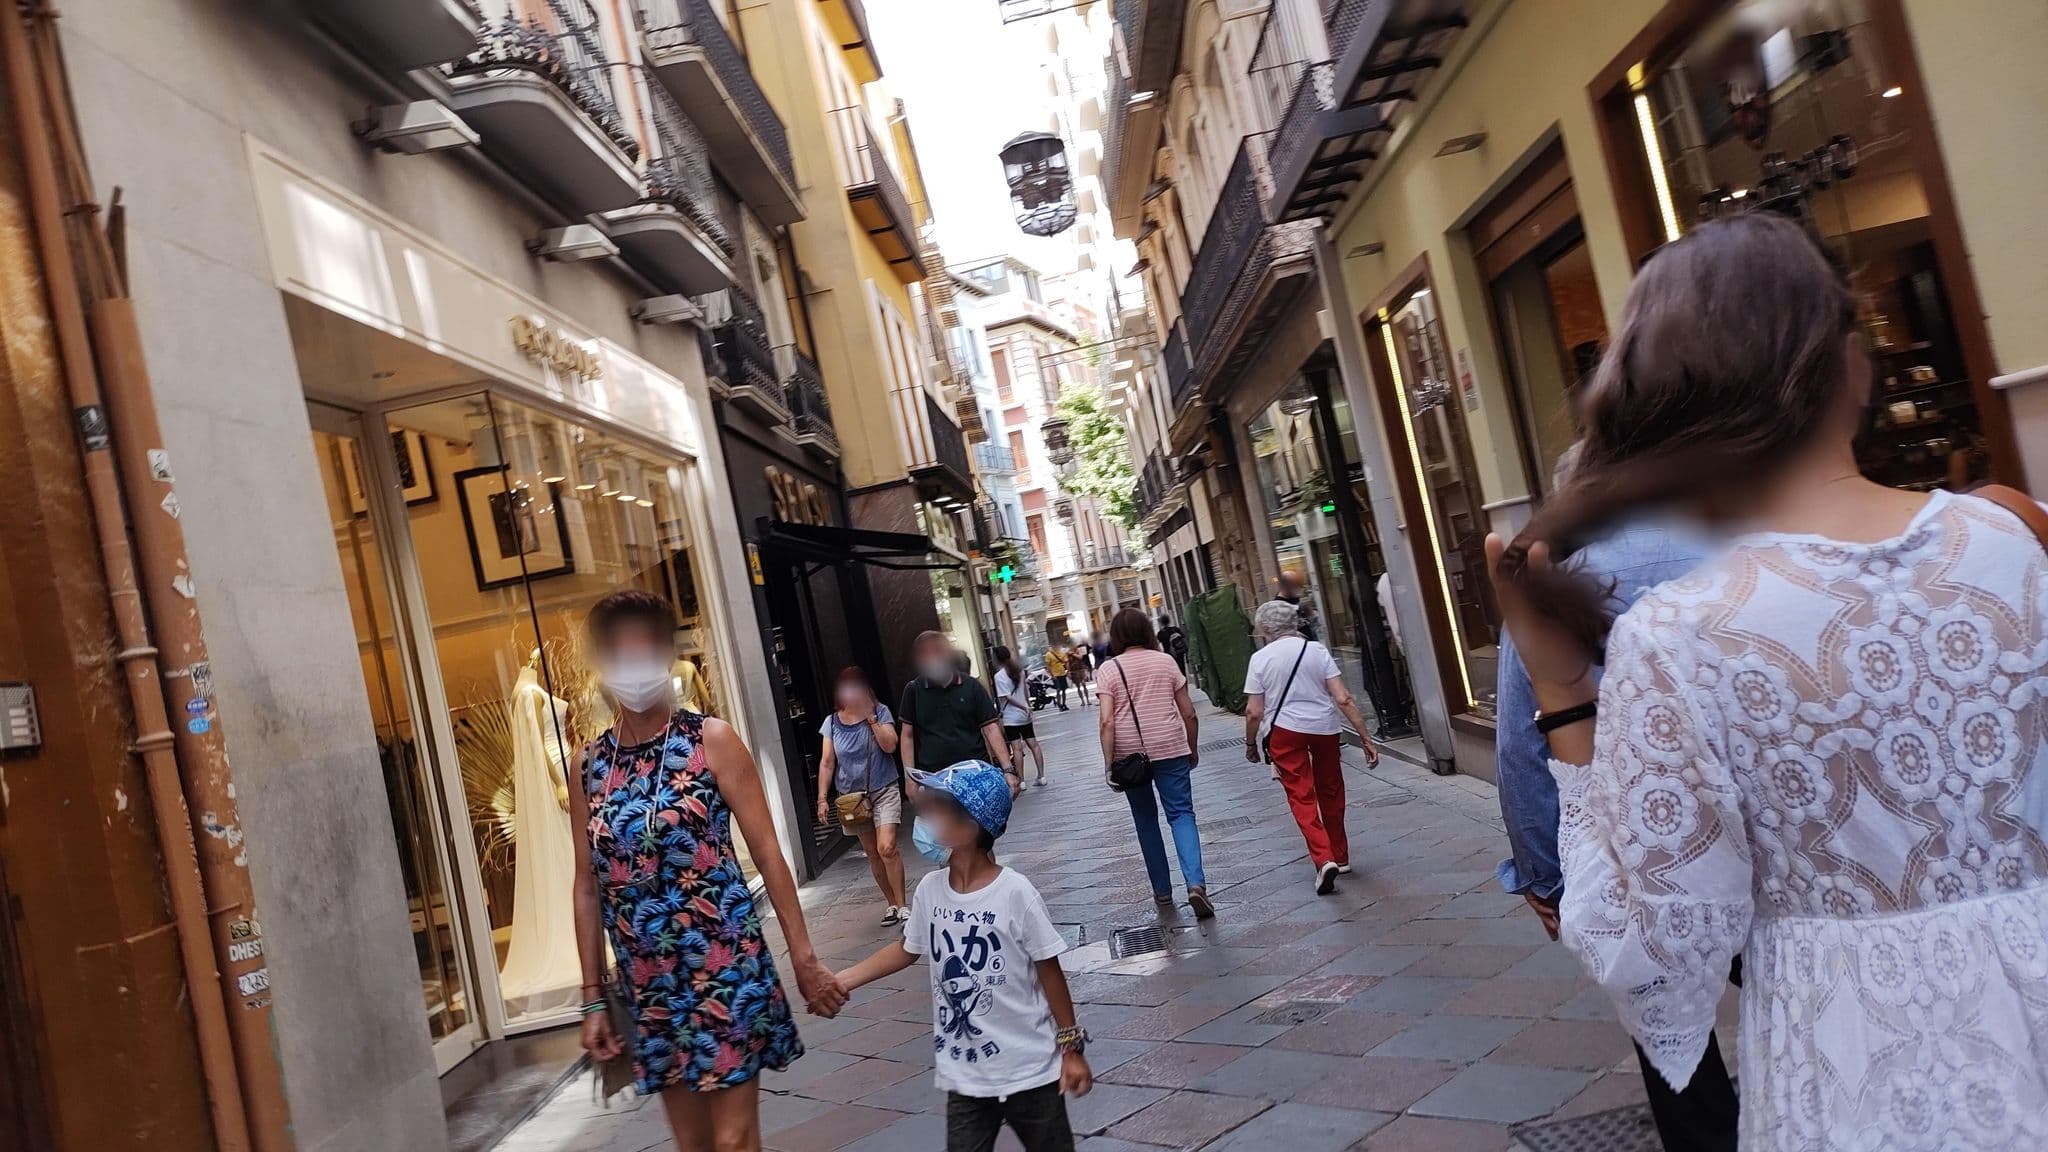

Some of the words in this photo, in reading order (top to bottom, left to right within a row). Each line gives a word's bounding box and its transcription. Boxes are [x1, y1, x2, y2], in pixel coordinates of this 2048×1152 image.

[933, 906, 996, 925] いい食べ物
[930, 922, 1001, 972] いか
[984, 974, 1008, 987] 東京
